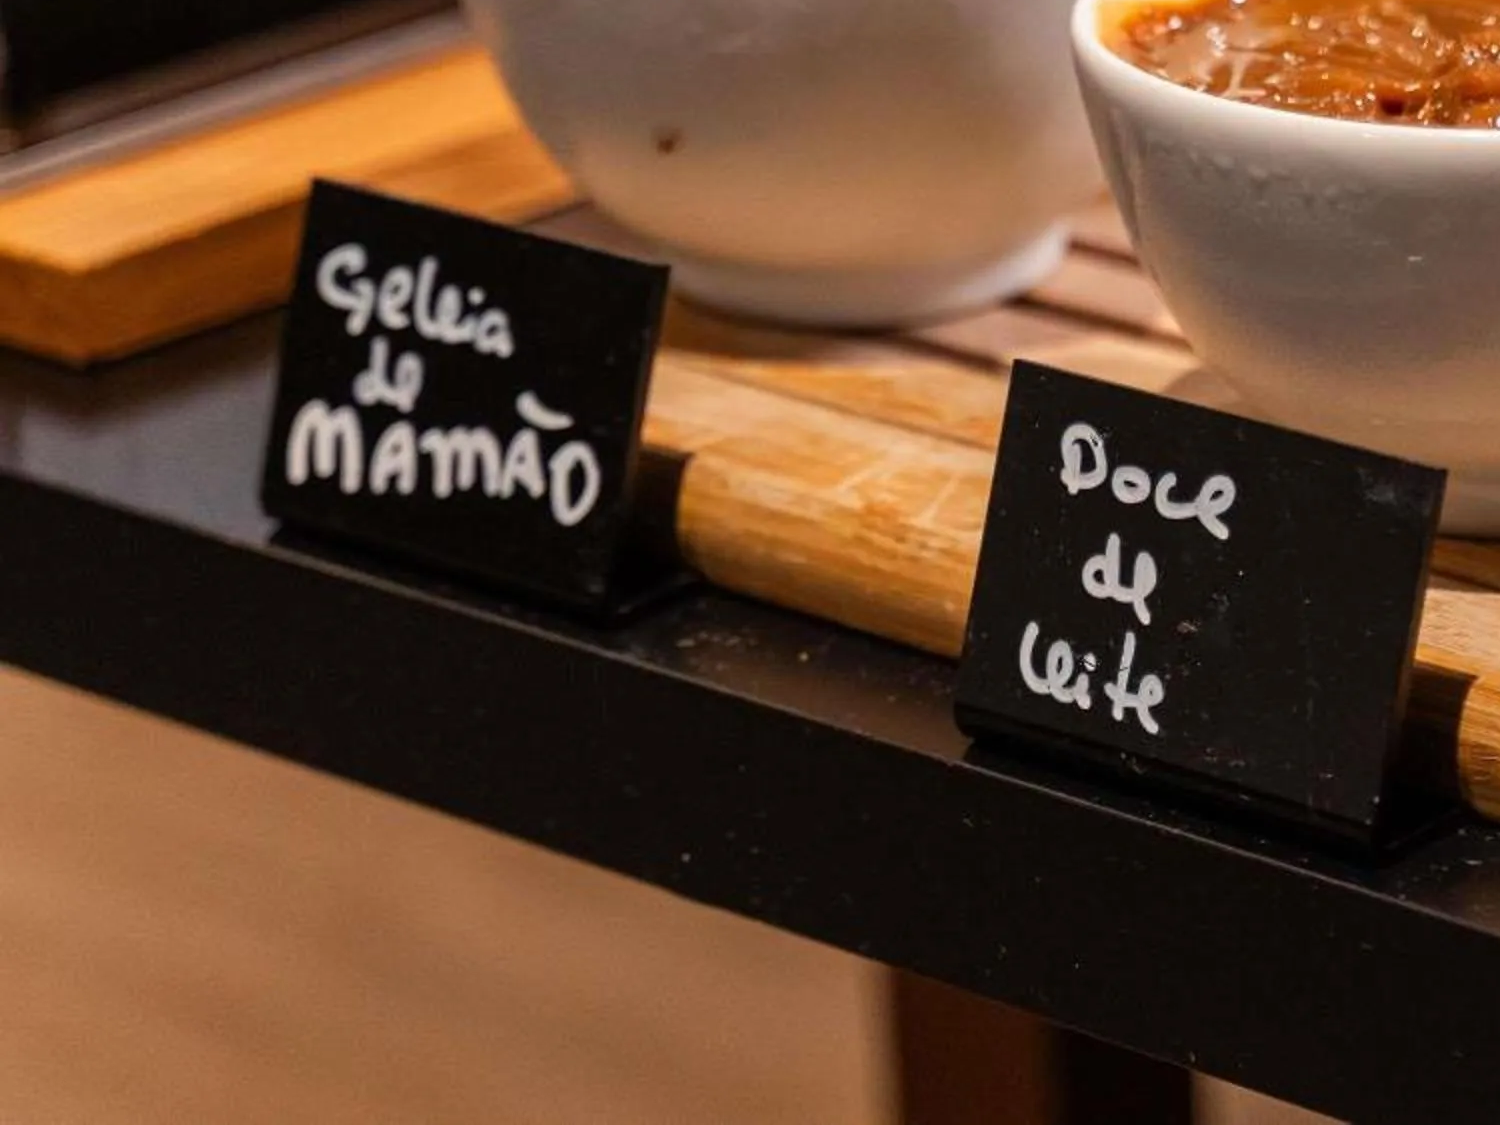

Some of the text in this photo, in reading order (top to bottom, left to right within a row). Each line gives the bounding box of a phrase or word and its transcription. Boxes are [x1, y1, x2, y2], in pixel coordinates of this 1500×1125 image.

[316, 242, 515, 359] Geleia
[352, 335, 425, 414] de
[1058, 421, 1238, 542] Doce
[1080, 531, 1159, 628] de
